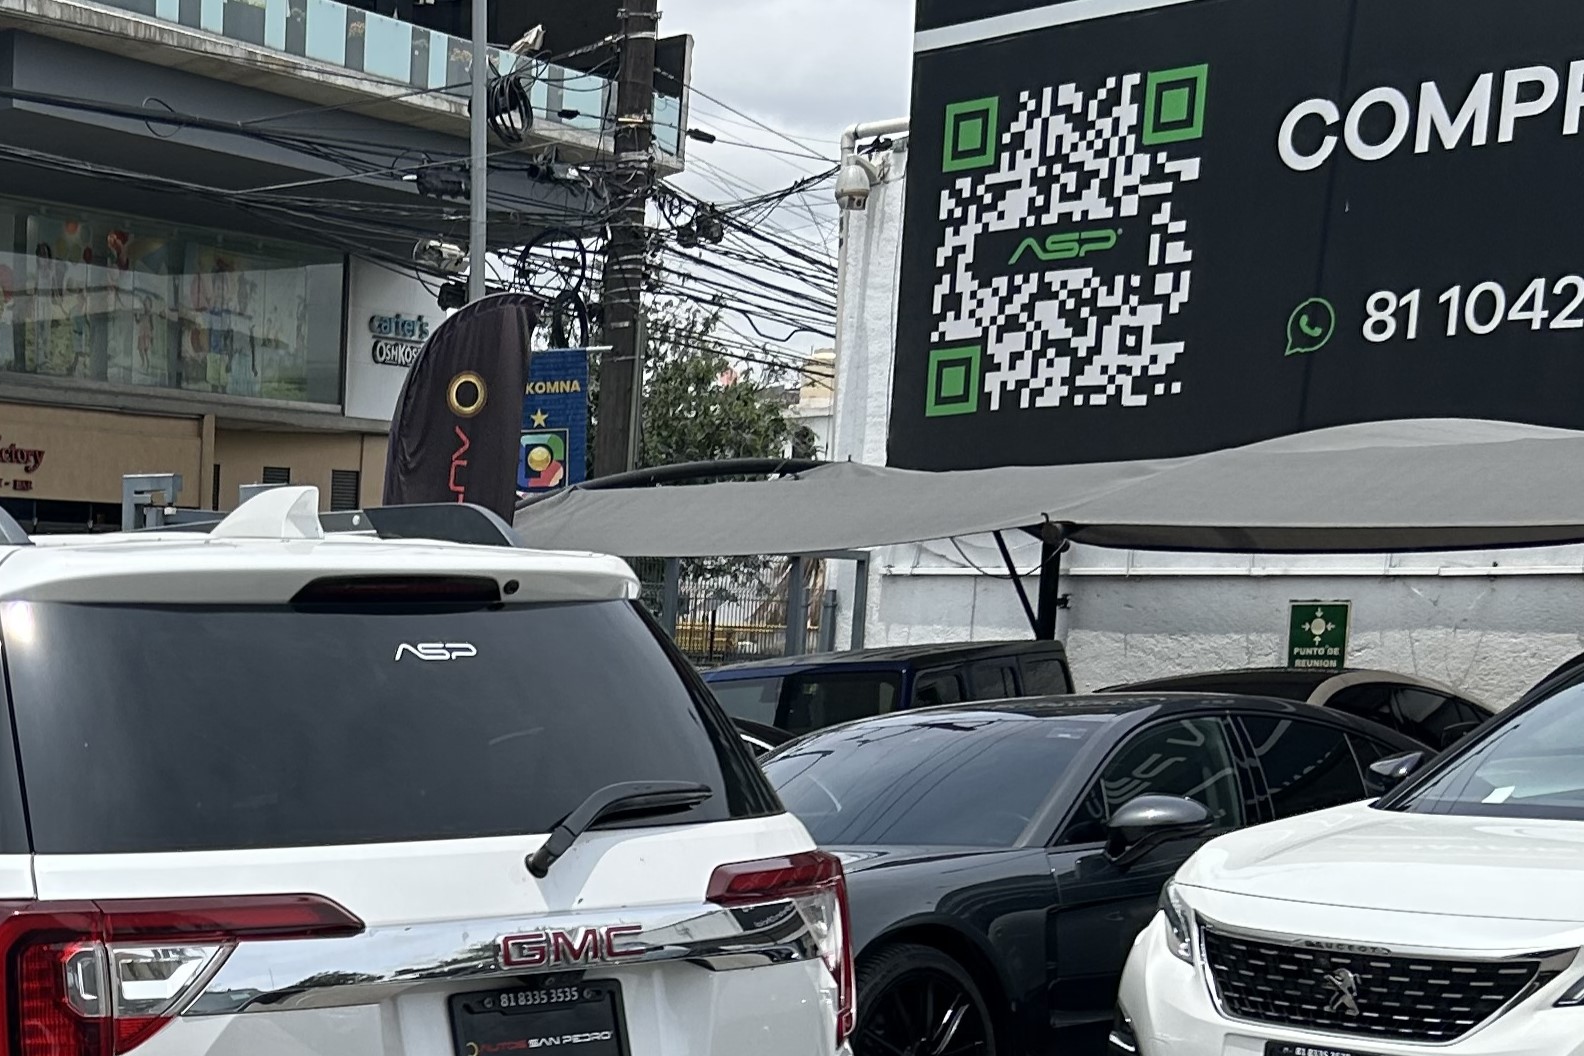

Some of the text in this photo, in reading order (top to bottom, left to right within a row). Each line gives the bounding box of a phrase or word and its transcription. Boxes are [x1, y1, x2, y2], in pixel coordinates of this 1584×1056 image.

[1363, 274, 1584, 342] 81 1042
[376, 341, 422, 365] OSHKOS
[1293, 646, 1340, 656] PUNTO DE
[1294, 659, 1337, 668] REUNION
[497, 923, 647, 970] GMC
[500, 986, 578, 1007] 81 8335 3535
[1294, 1046, 1306, 1056] 81
